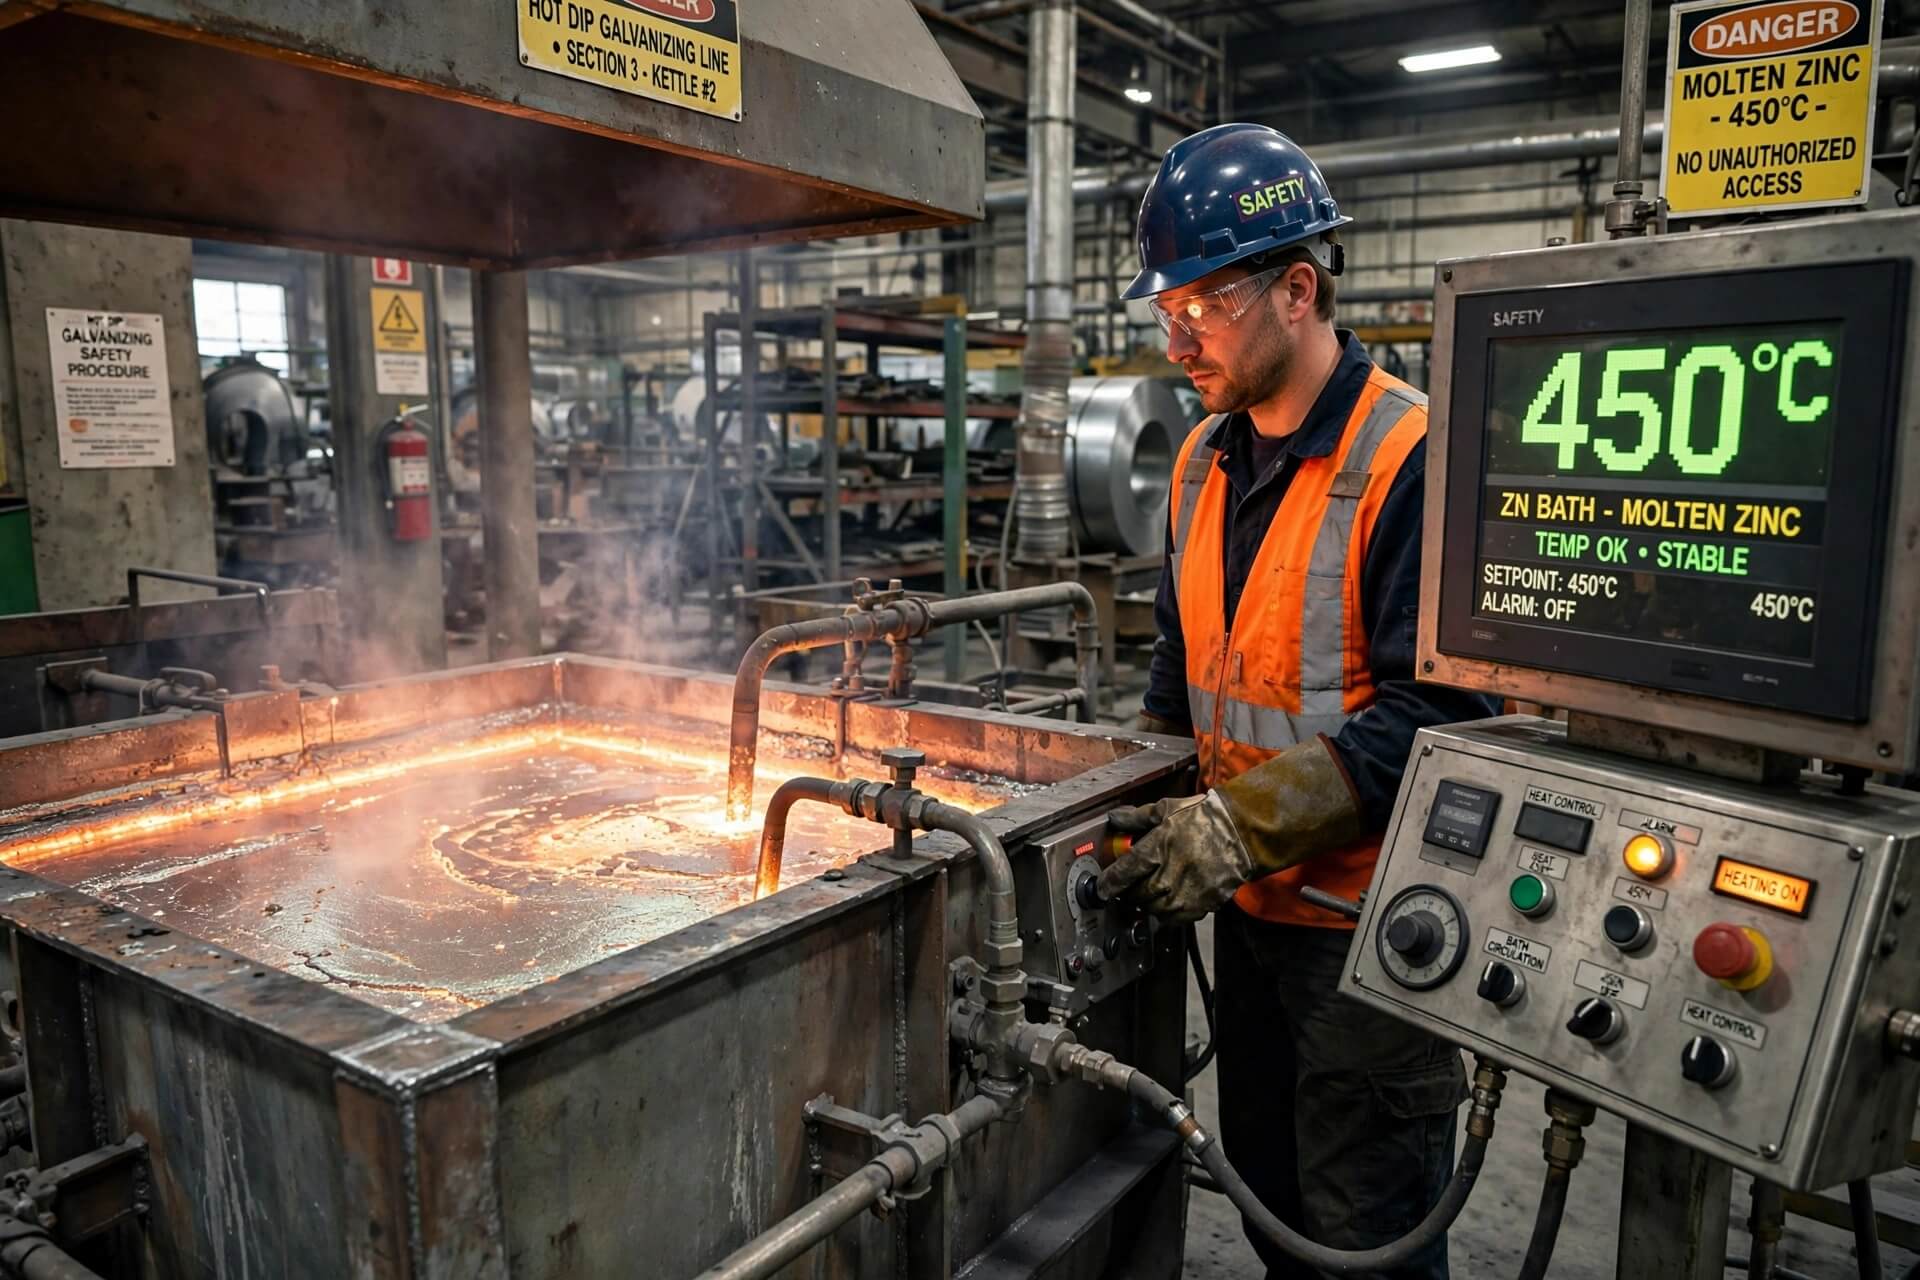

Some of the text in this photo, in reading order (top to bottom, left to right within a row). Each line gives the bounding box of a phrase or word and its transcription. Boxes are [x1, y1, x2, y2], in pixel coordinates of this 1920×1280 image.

[529, 0, 729, 76] HOT DIP GALVANIZING LINE
[1705, 7, 1840, 50] DANGER
[566, 38, 627, 79] SECTION
[630, 57, 639, 82] 3
[652, 63, 699, 98] KETTLE
[701, 78, 717, 103] #2
[1682, 53, 1861, 100] MOLTEN ZINC
[1729, 93, 1809, 127] 450°C
[1676, 136, 1857, 175] NO UNAUTHORIZED
[1239, 176, 1306, 216] SAFETY
[1722, 170, 1803, 199] ACCESS
[1493, 308, 1544, 327] SAFETY
[61, 327, 153, 346] GALVANIZING
[67, 363, 151, 379] PROCEDURE
[80, 347, 132, 362] SAFETY
[1521, 340, 1833, 475] 450°C
[1500, 491, 1529, 519] ZN
[1536, 493, 1596, 523] BATH
[1621, 498, 1726, 532] MOLTEN
[1733, 504, 1802, 537] ZINC
[1535, 530, 1590, 559] TEMP
[1596, 535, 1629, 564] OK
[1656, 540, 1750, 576] STABLE
[1483, 562, 1618, 599] SETPOINT: 450°C
[1481, 590, 1577, 622] ALARM: OFF
[1750, 591, 1815, 623] 450°C
[1529, 788, 1598, 816] HEAT CONTROL
[1723, 867, 1802, 903] HEATING ON
[1506, 935, 1530, 951] BATH
[1686, 1002, 1712, 1023] HEAT
